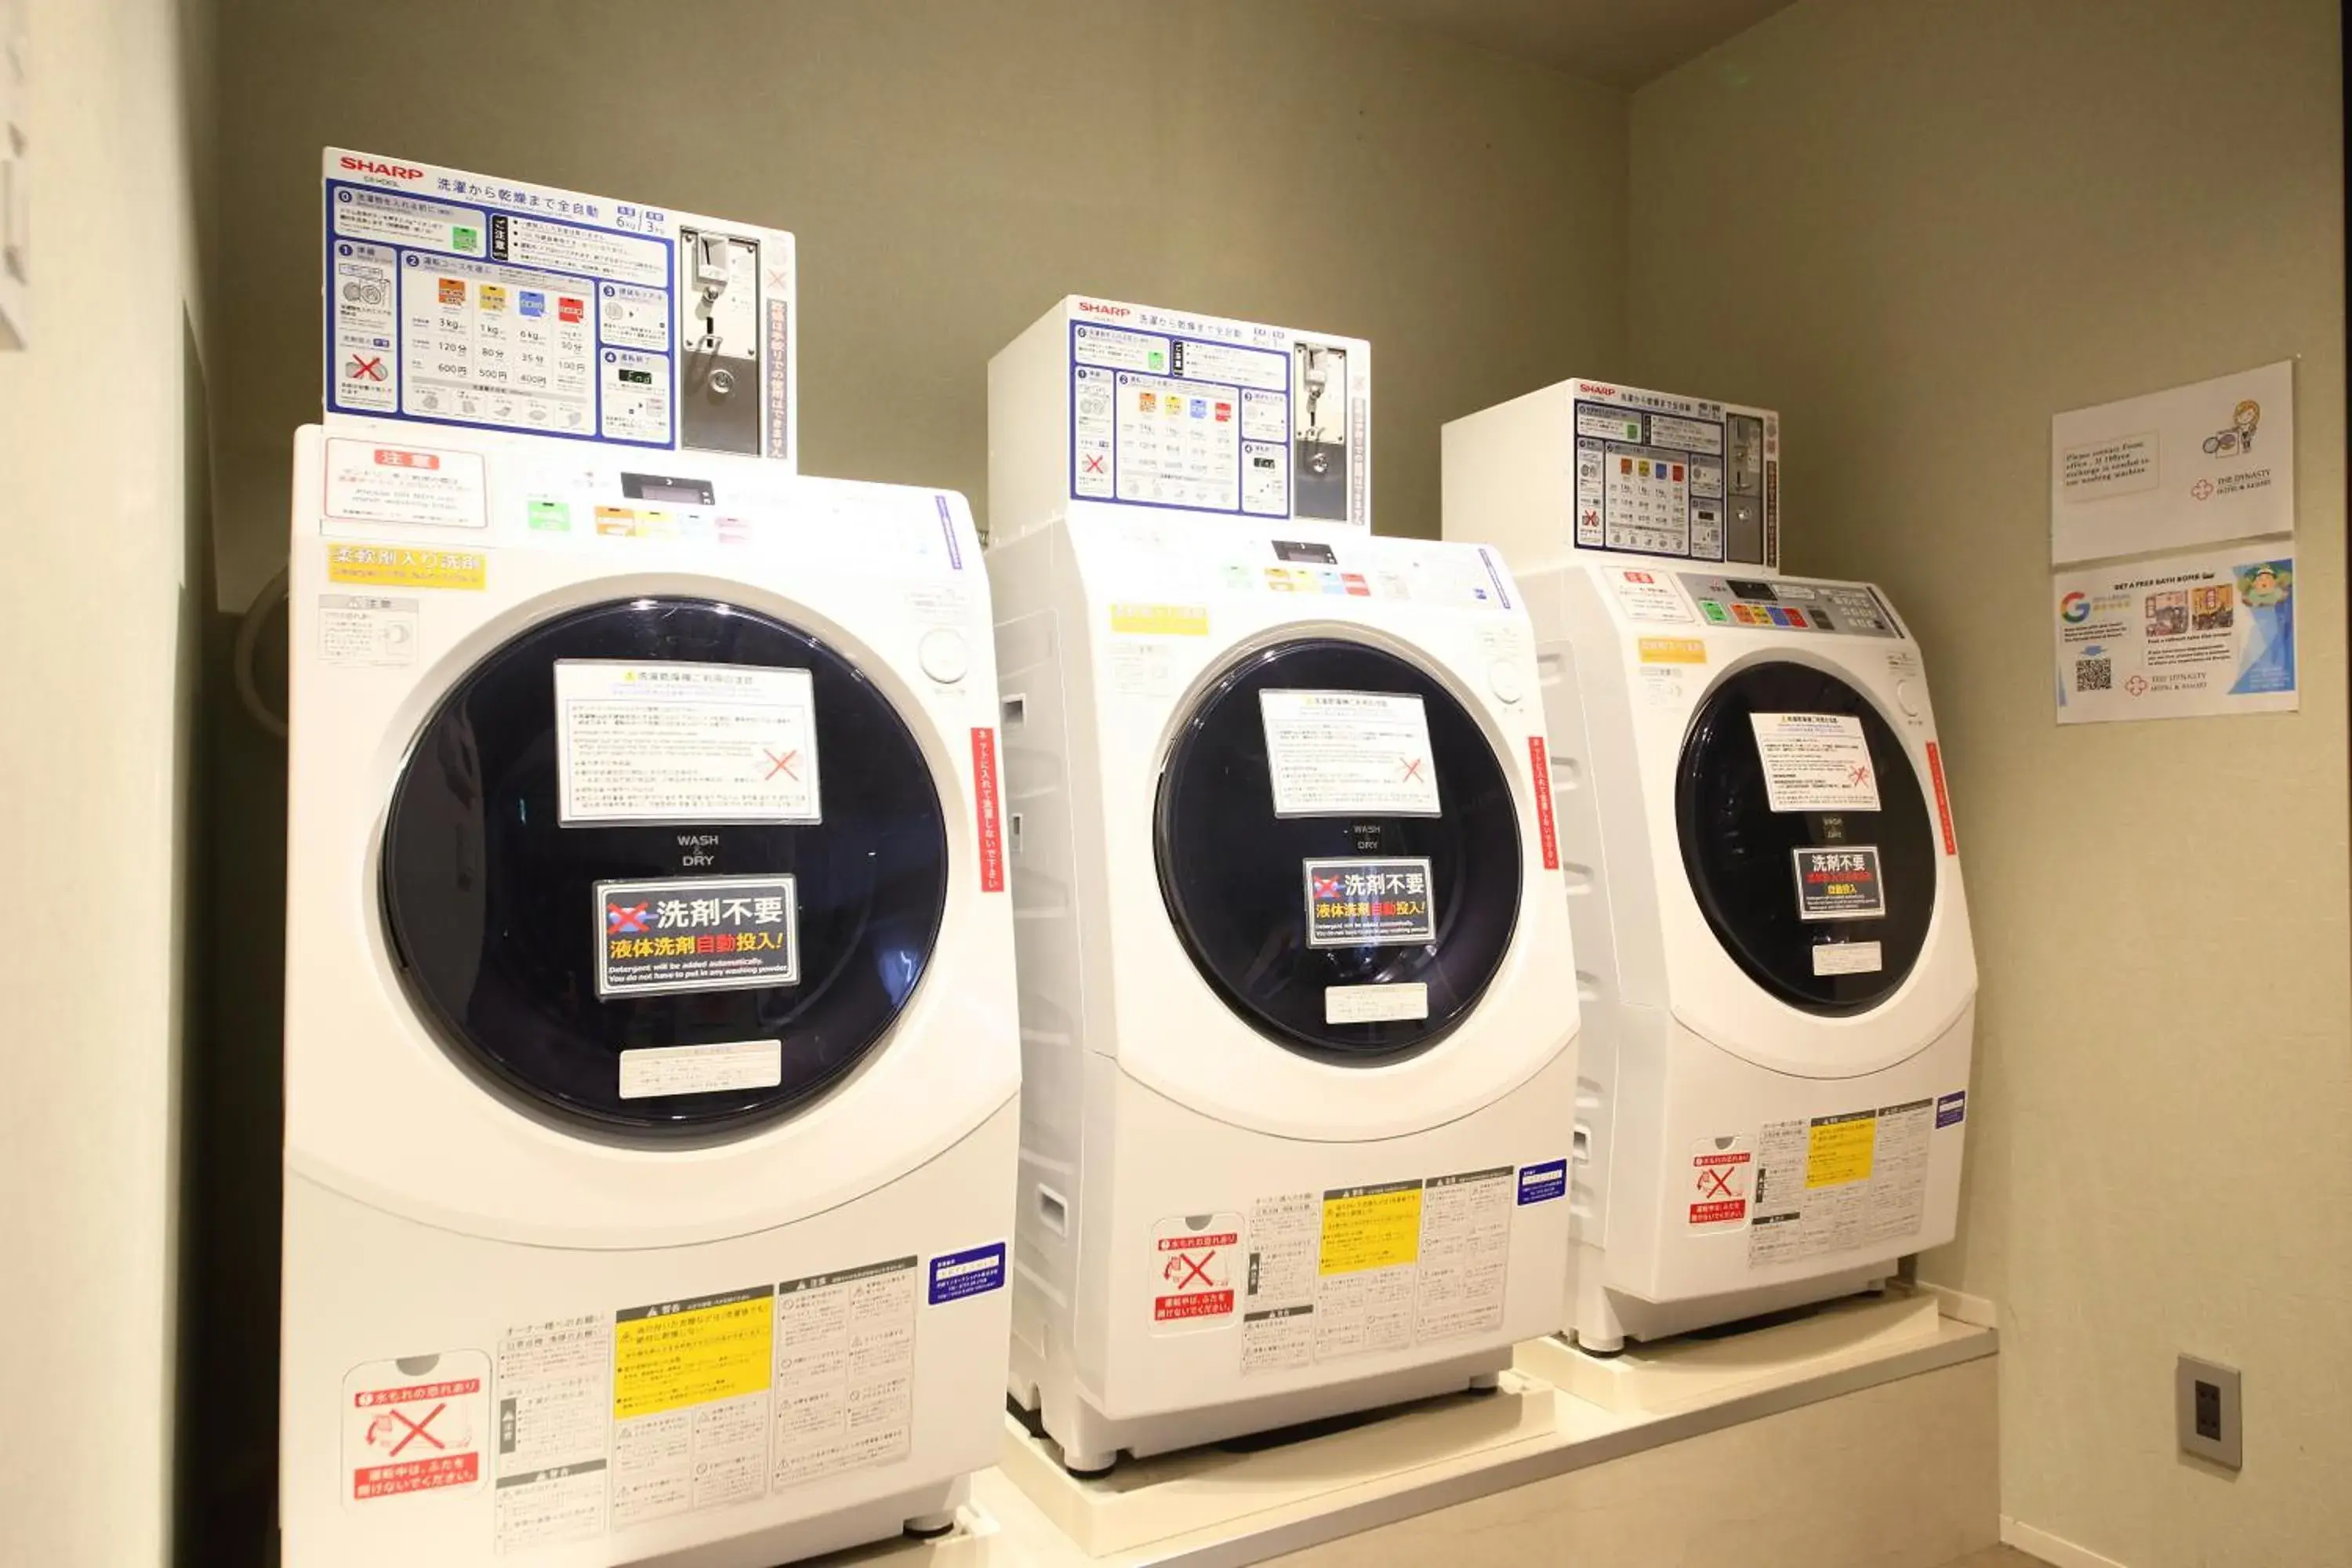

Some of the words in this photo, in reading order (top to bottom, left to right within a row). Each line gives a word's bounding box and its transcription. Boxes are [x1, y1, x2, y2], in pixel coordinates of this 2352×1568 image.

[340, 156, 424, 180] SHARP
[437, 176, 600, 218] 洗濯から乾燥まで全自動
[1078, 302, 1131, 317] SHARP
[1580, 383, 1616, 396] SHARP
[2234, 467, 2271, 481] DYNASTY
[677, 835, 719, 846] WASH
[683, 855, 714, 866] DRY
[1812, 854, 1865, 872] 洗剤不要
[1345, 873, 1425, 896] 洗剤不要
[657, 896, 783, 929] 洗剤不要
[608, 964, 652, 975] Detergent
